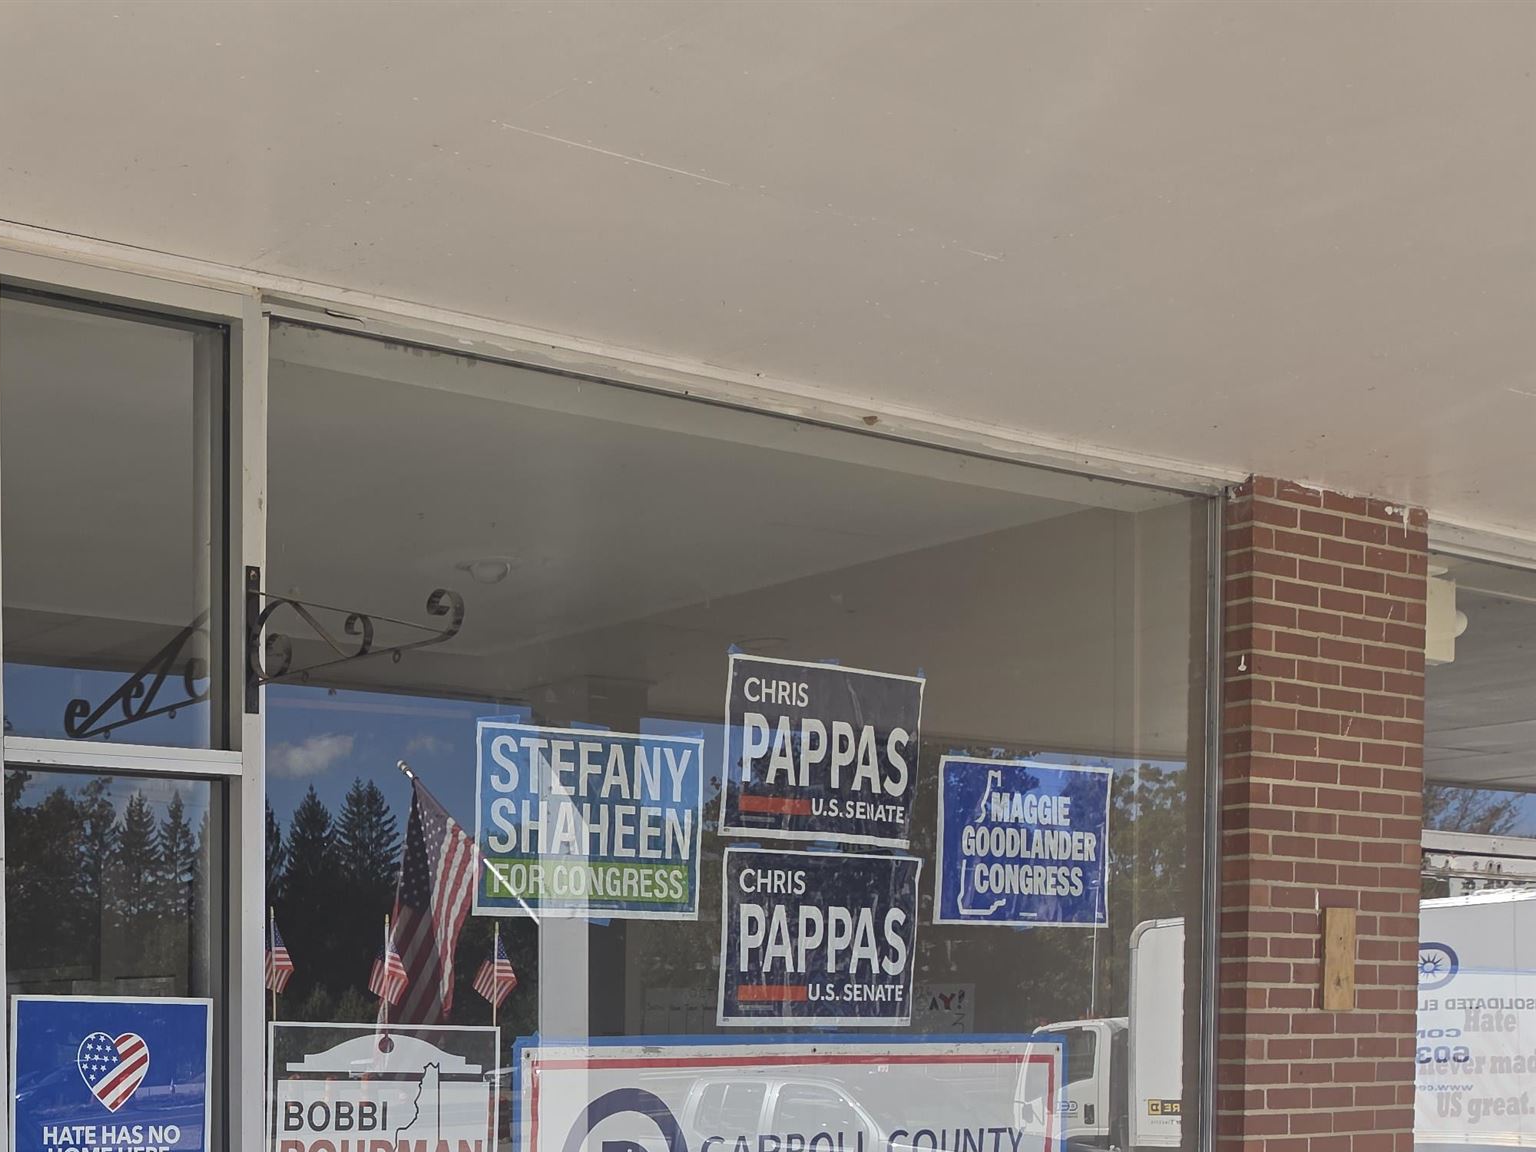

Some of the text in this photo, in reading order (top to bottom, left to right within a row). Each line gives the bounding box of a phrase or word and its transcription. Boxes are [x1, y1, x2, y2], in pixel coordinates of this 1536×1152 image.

[744, 677, 809, 707] CHRIS
[490, 735, 692, 802] STEFANY
[741, 712, 910, 797] PAPPAS
[811, 798, 905, 824] U.S. SENATE
[990, 792, 1071, 826] MAGGIE
[488, 798, 692, 860] SHAHEEN
[962, 825, 1096, 862] GOODLANDER
[493, 863, 683, 899] FOR CONGRESS
[739, 868, 806, 895] CHRIS
[974, 863, 1084, 897] CONGRESS
[739, 903, 907, 976] PAPPAS
[808, 984, 839, 1001] U.S.
[843, 984, 904, 1002] SENATE
[1464, 1009, 1516, 1032] Hate
[283, 1101, 387, 1131] BOBBI
[1437, 1091, 1536, 1125] US great.
[43, 1125, 181, 1145] HATE HAS NO
